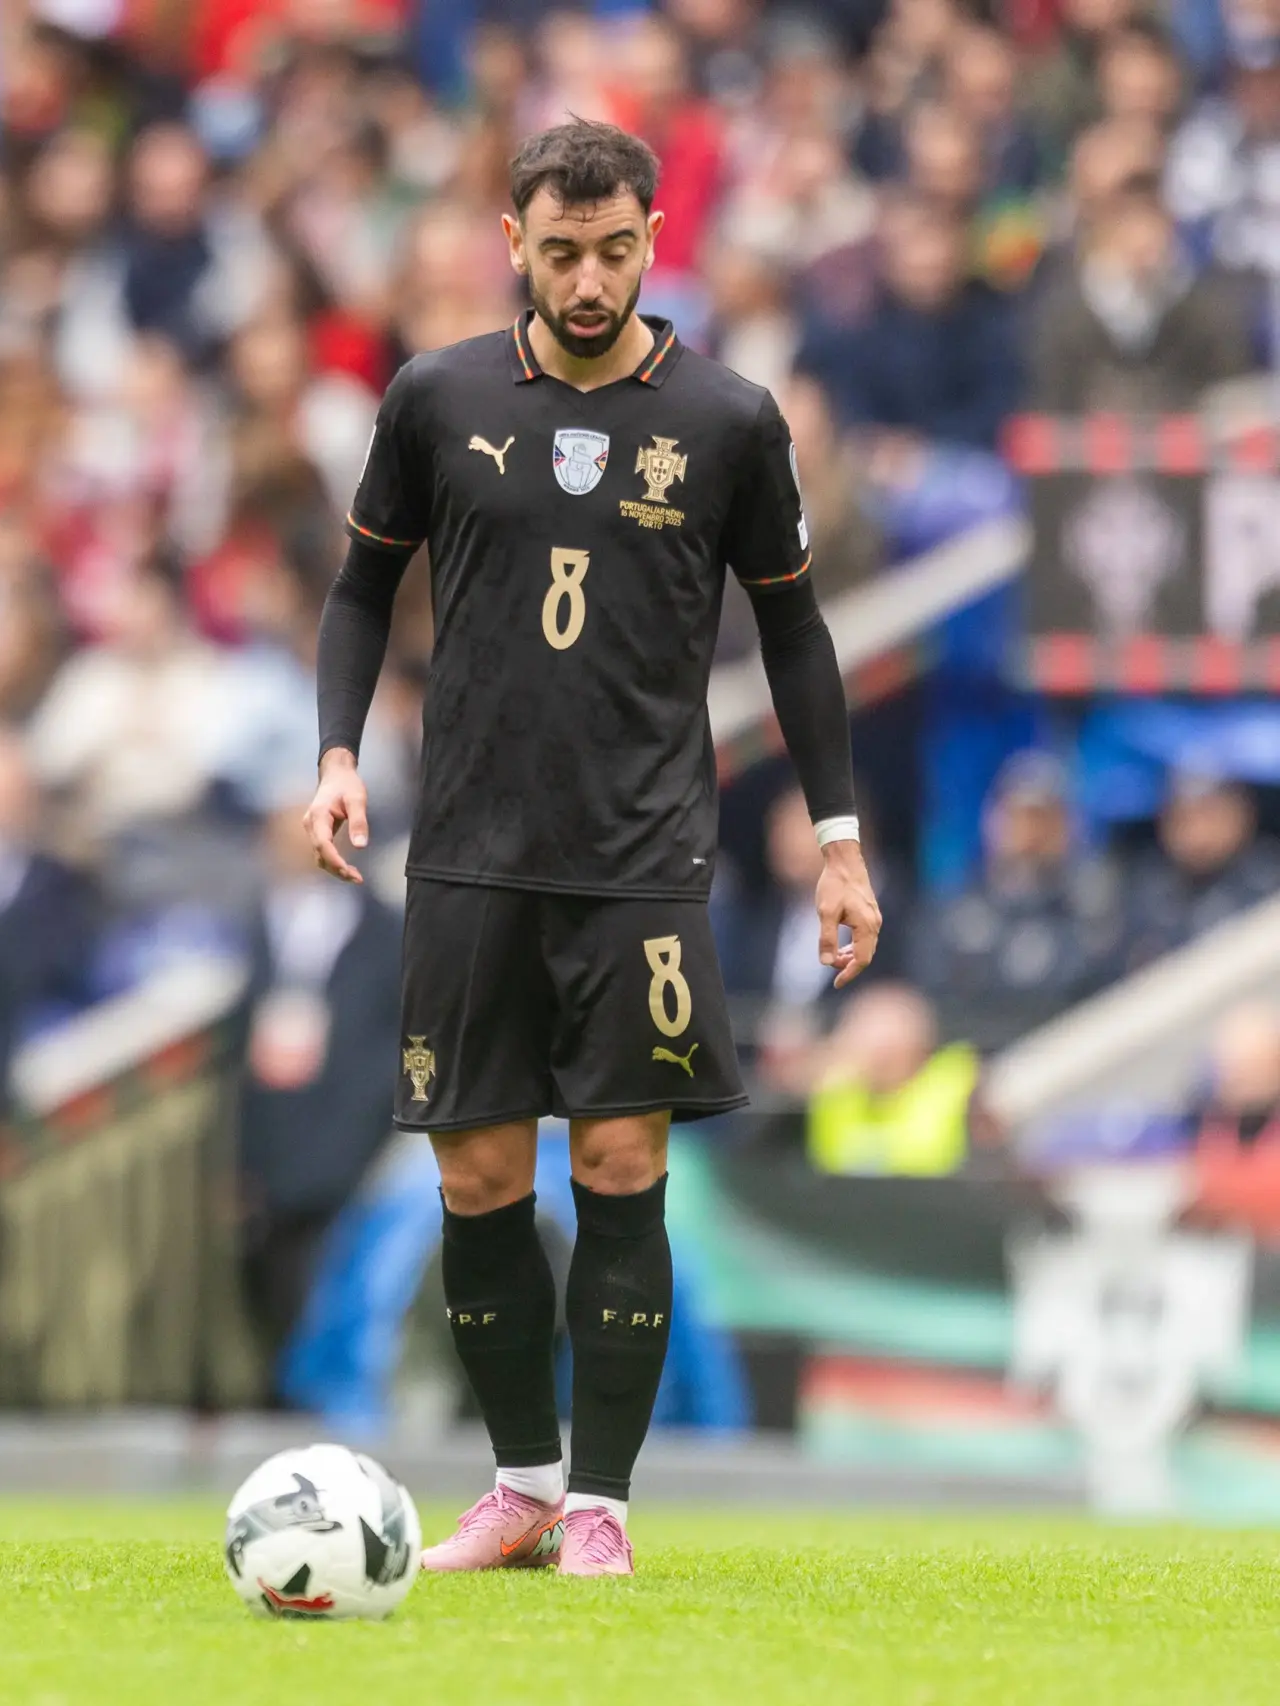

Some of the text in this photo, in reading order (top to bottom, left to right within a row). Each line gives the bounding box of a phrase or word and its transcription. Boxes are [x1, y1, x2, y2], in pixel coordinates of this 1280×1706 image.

[629, 510, 664, 523] NOVEMBRO
[665, 516, 682, 527] 2025
[638, 519, 663, 530] PORTO
[542, 546, 590, 650] 8
[644, 934, 692, 1038] 8
